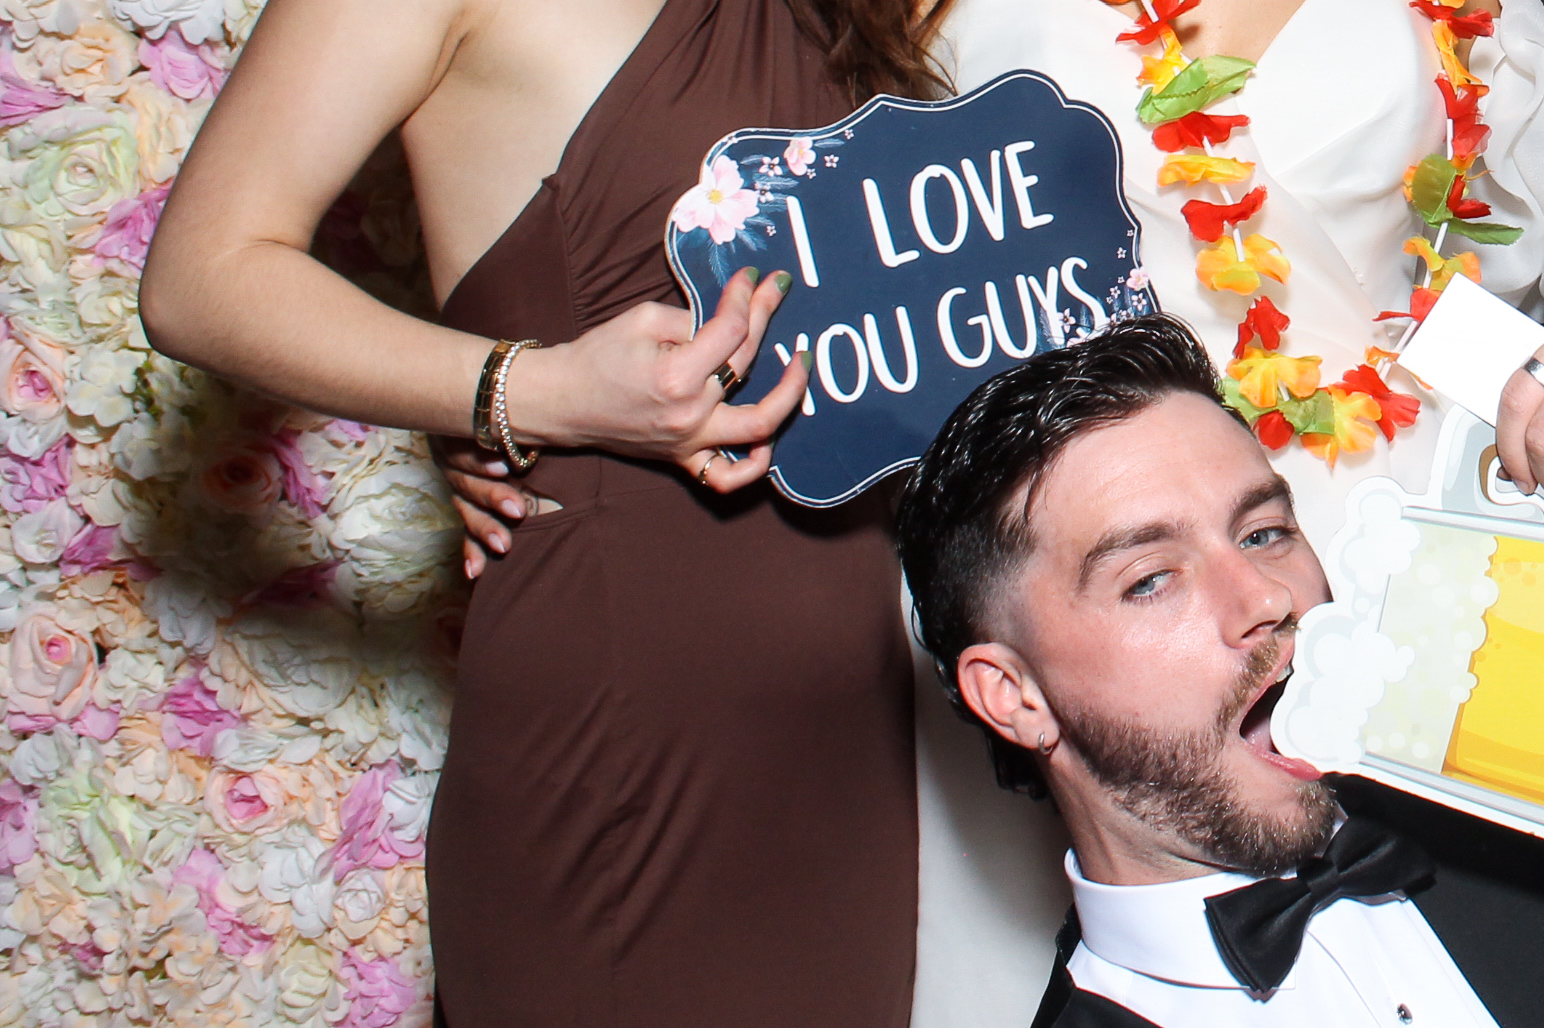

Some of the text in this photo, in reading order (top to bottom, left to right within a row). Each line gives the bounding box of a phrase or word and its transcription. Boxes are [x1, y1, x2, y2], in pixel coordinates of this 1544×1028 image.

[786, 140, 1055, 288] I LOVE
[774, 306, 919, 416] YOU
[937, 256, 1110, 368] GUYS
